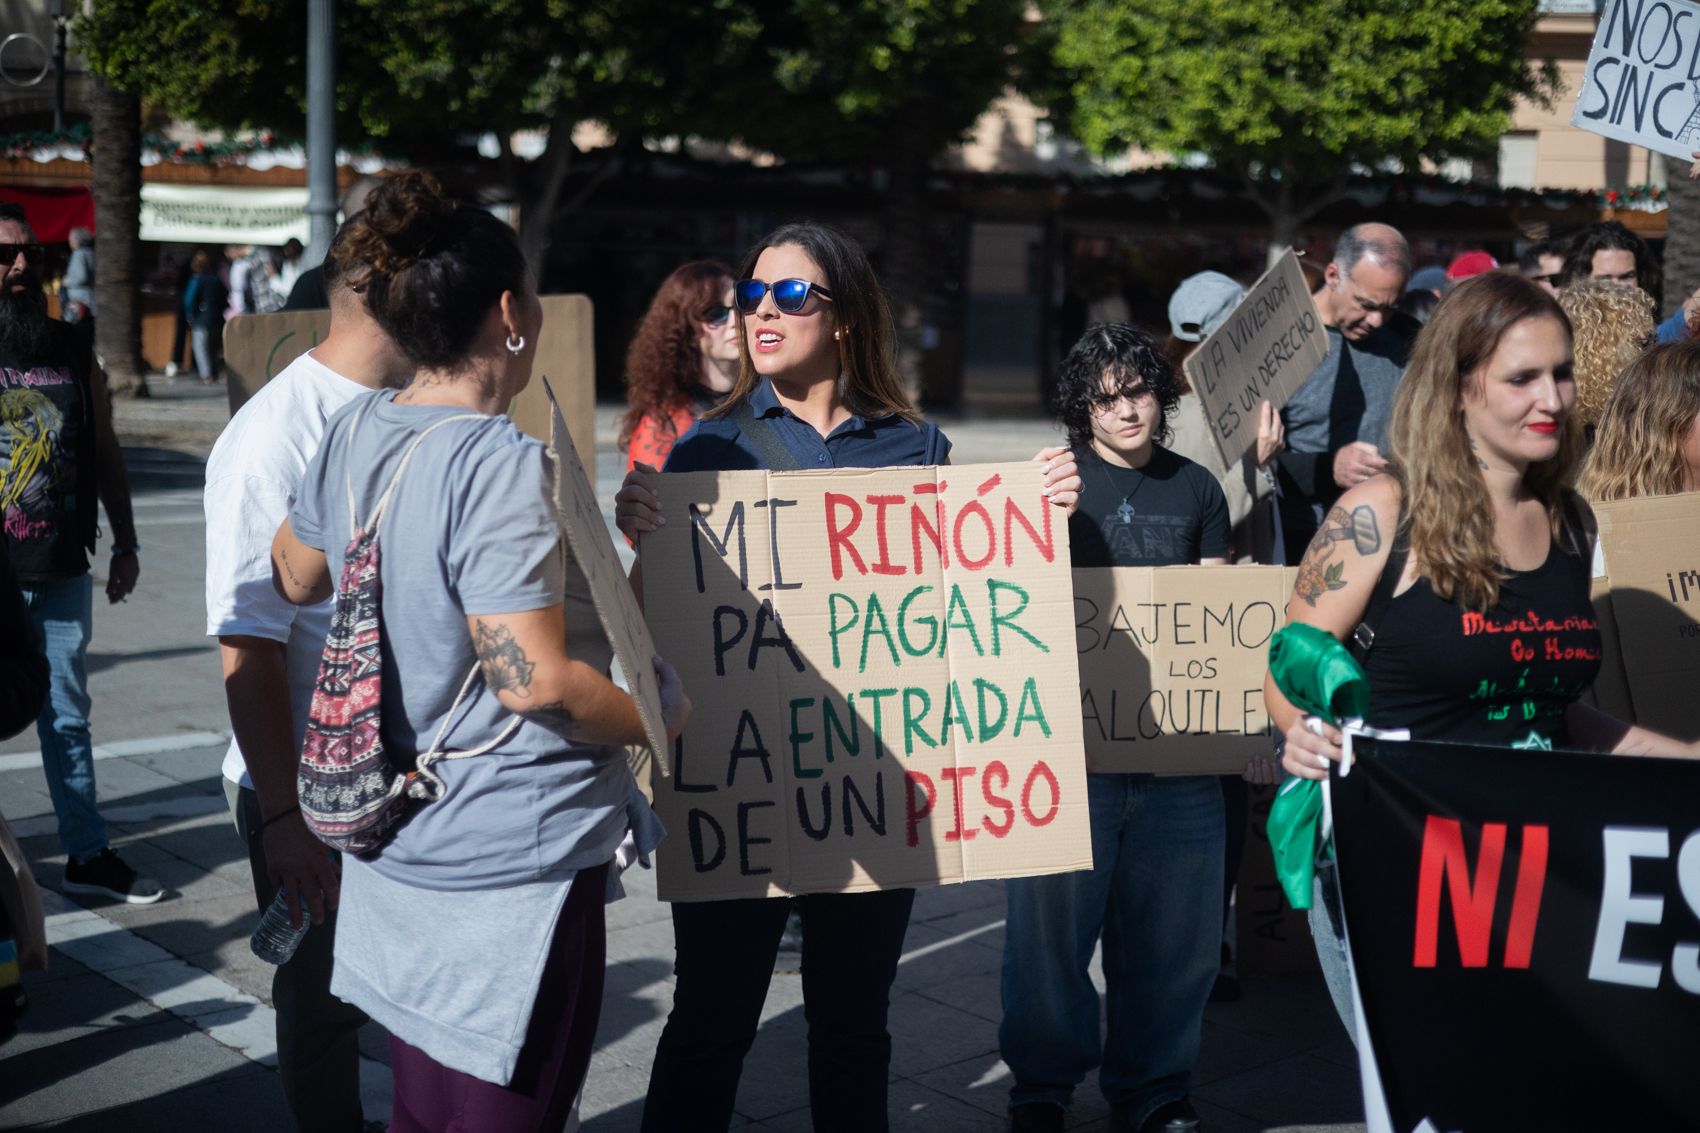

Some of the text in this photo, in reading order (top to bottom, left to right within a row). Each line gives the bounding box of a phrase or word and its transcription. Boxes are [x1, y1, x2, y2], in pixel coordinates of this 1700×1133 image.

[1603, 0, 1693, 70] NOS
[1200, 276, 1290, 395] LA VIVIENDA
[1217, 311, 1316, 440] ES UN DERECHO
[689, 473, 1054, 593] MI RIÑÓN
[713, 578, 1051, 677] PA PAGAR
[1073, 597, 1290, 653] BAJEMO
[1169, 657, 1217, 679] LOS
[674, 677, 1052, 793] LA ENTRADA
[1081, 688, 1272, 742] ALQUILE
[688, 760, 1061, 876] DE UN PISO
[1413, 814, 1549, 969] NI
